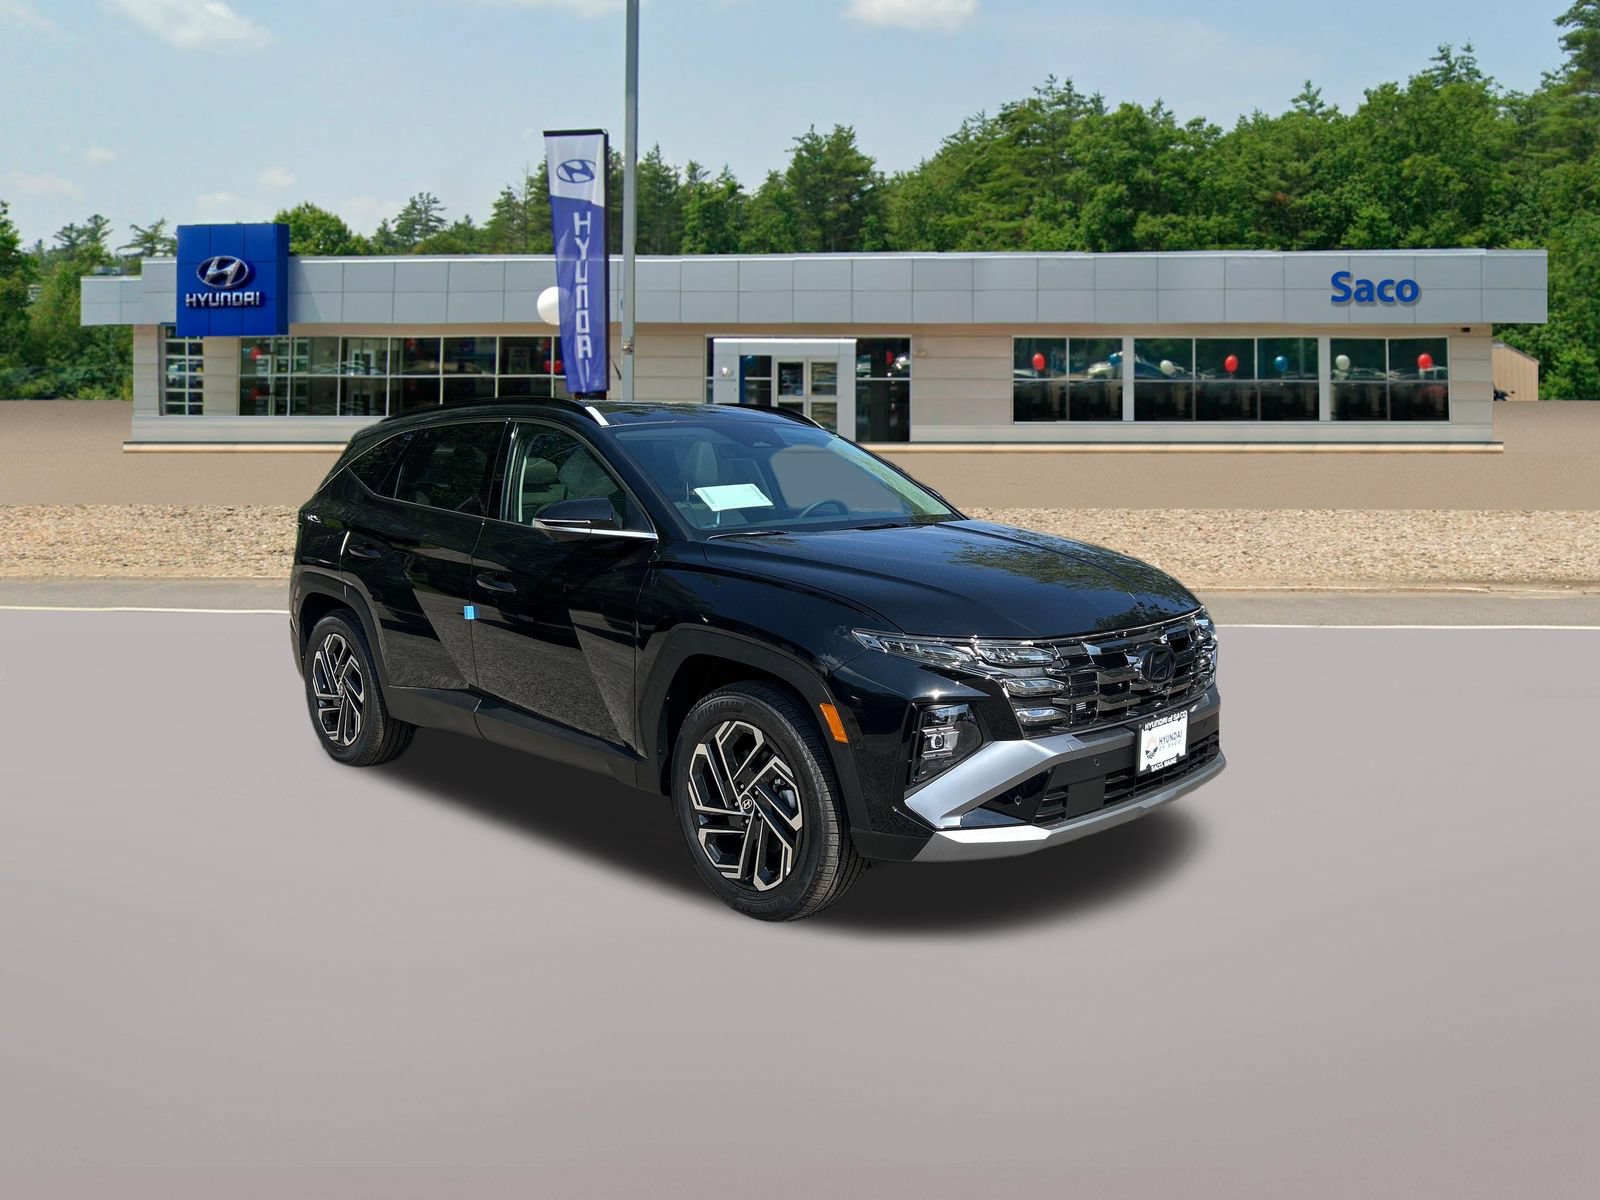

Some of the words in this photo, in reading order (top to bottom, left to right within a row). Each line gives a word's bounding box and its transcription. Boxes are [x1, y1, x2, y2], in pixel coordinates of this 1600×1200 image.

[1330, 270, 1420, 304] Saco
[186, 291, 260, 308] HYUNDAI
[573, 211, 592, 383] HYUNDAI
[1173, 710, 1187, 721] SACO
[1159, 730, 1182, 744] HYUNDAI
